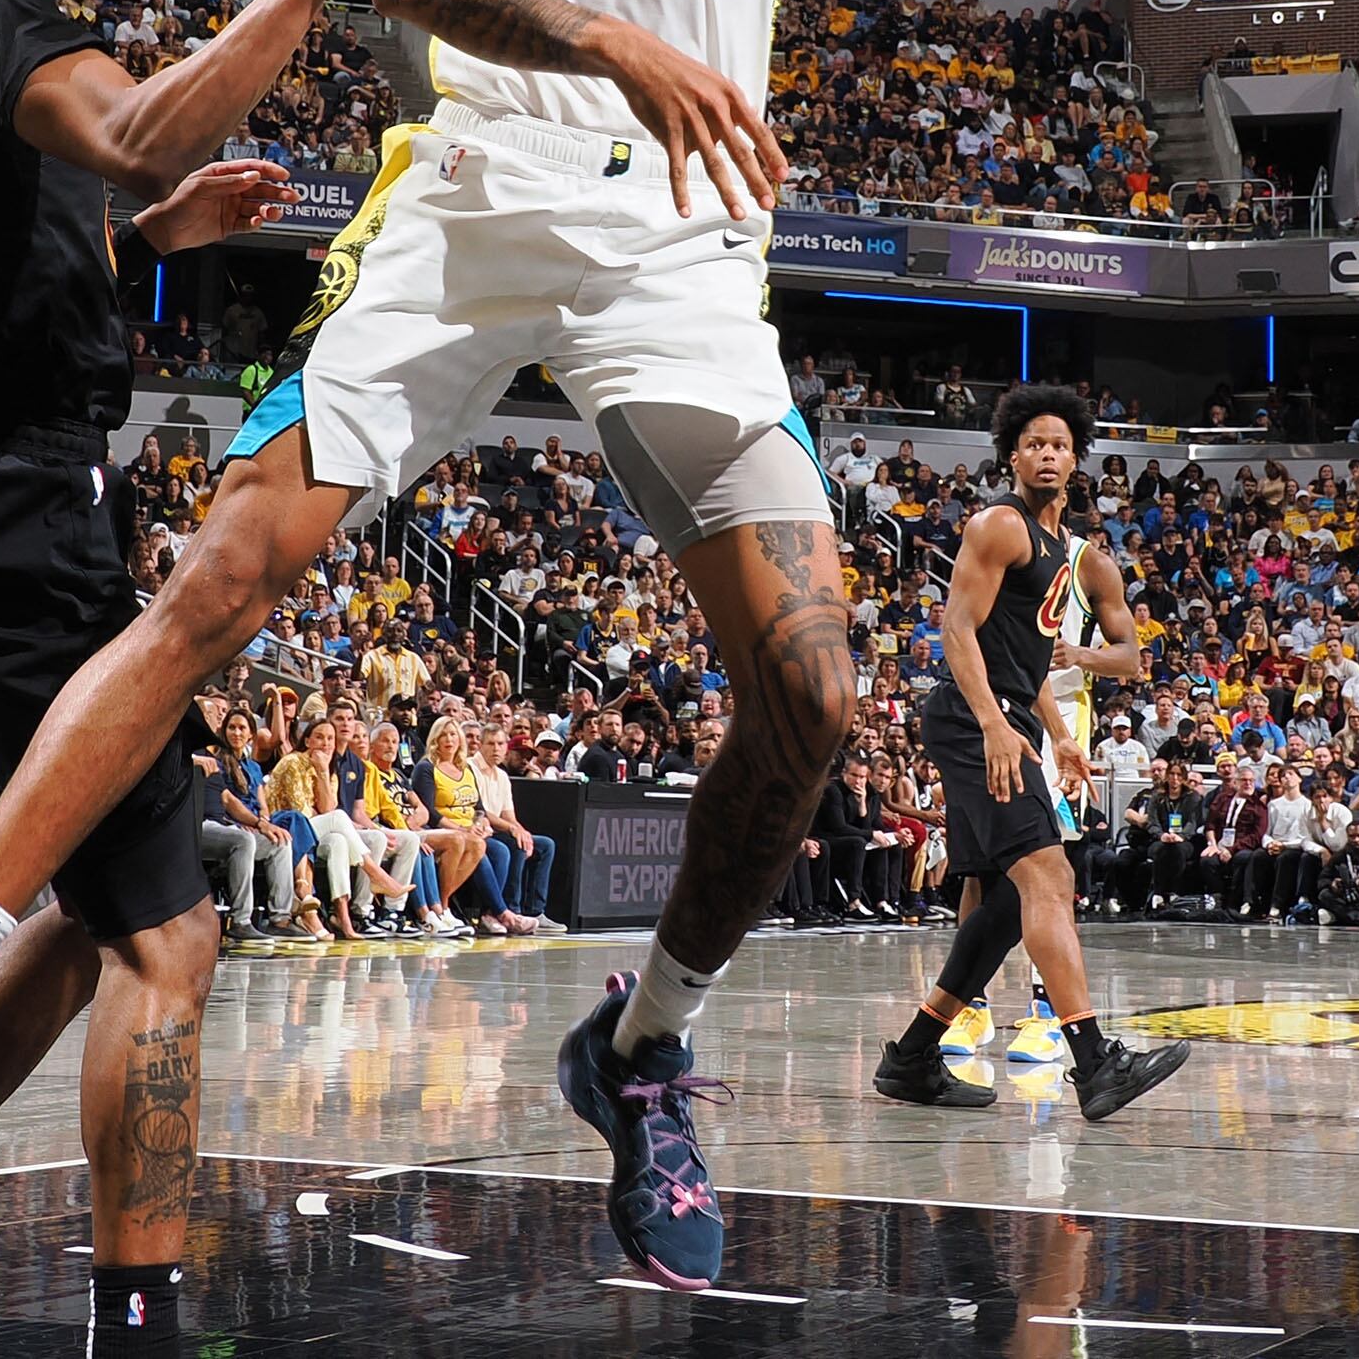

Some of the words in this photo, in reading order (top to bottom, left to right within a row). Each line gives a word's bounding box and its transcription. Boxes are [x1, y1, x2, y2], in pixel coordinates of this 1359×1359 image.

[1252, 9, 1328, 25] LOFT
[295, 206, 353, 220] NETWORK
[771, 234, 820, 251] ports
[822, 234, 863, 253] Tech
[866, 238, 896, 255] HQ
[975, 237, 1030, 275] Jack's
[1030, 249, 1123, 275] DONUTS
[1015, 272, 1051, 284] SINCE
[163, 1042, 179, 1057] TO
[147, 1054, 193, 1081] GARY
